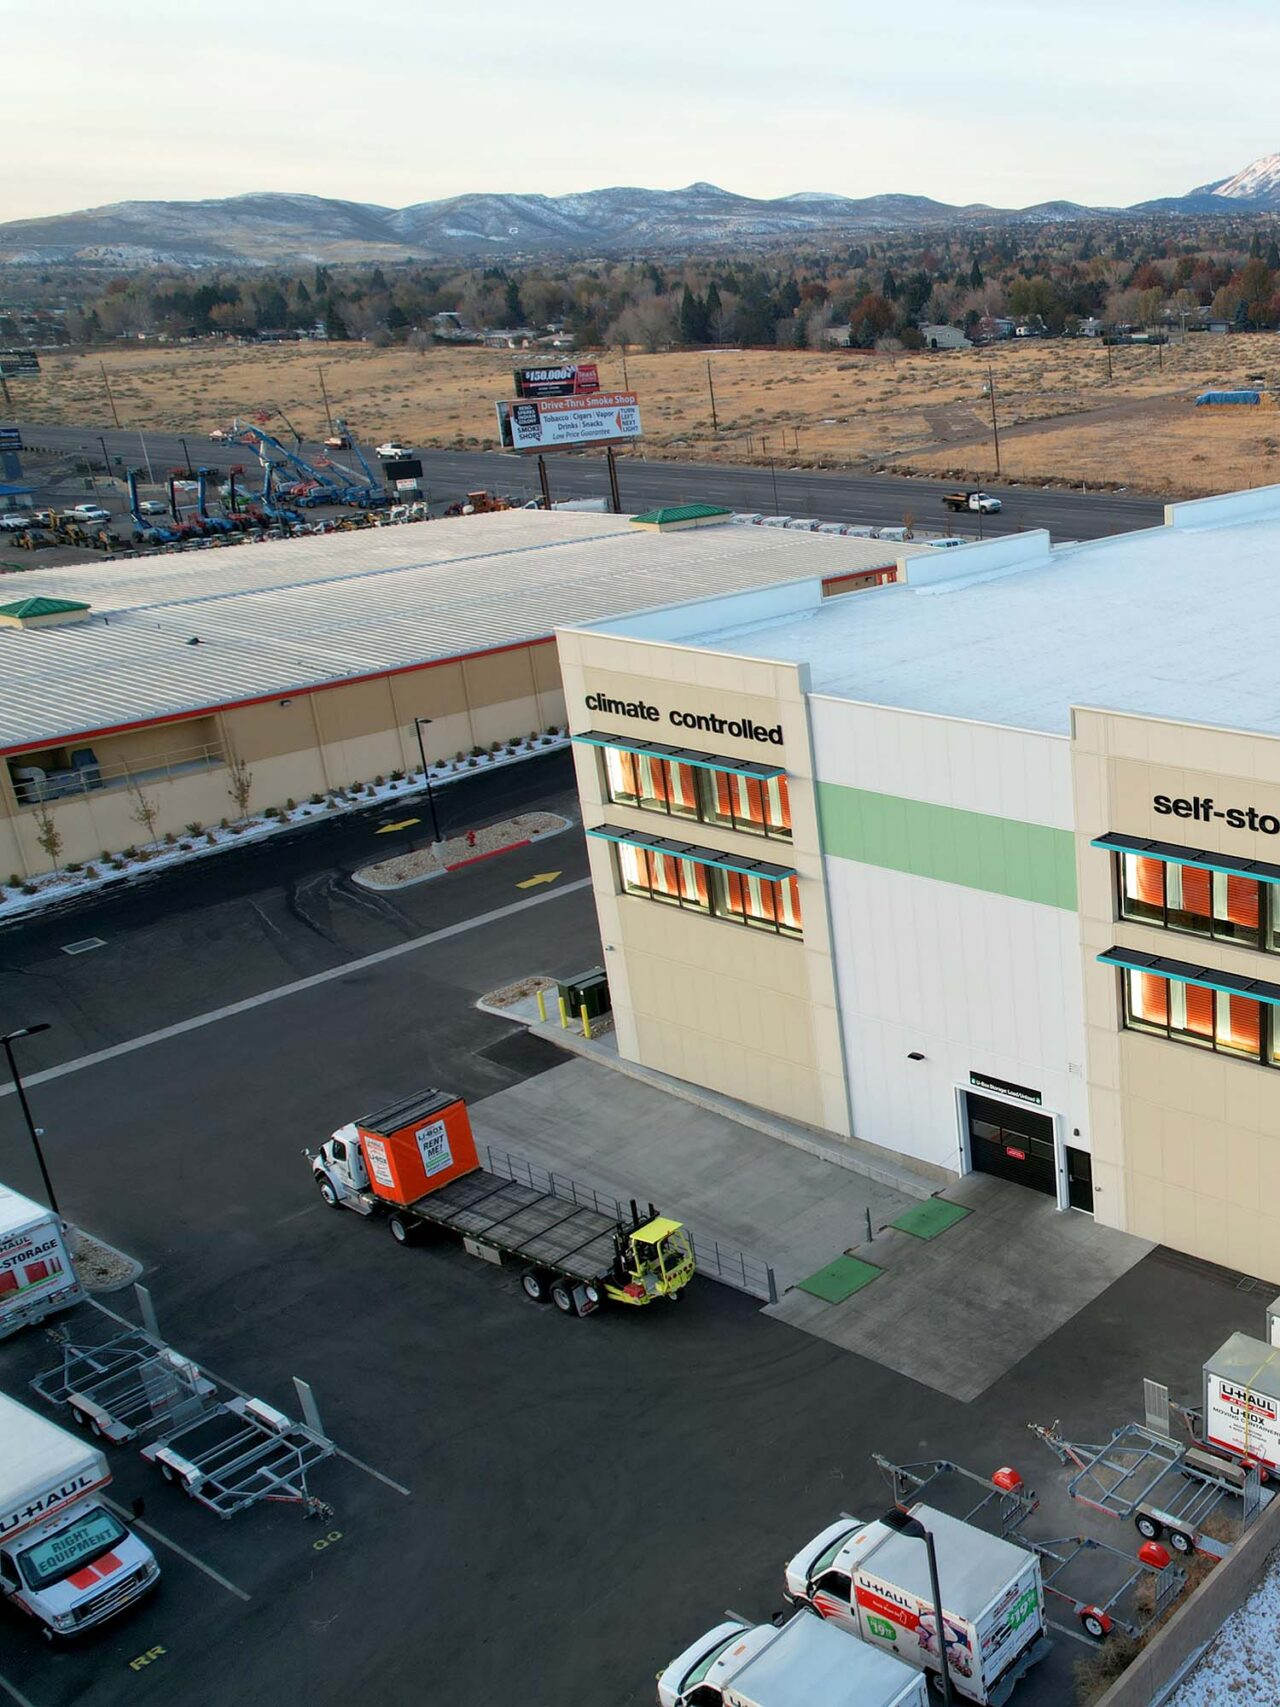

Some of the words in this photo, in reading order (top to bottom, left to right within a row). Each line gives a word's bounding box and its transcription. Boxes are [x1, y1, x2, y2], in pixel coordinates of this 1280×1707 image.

[541, 399, 585, 410] Drive-Thru
[586, 398, 612, 406] Smoke
[614, 395, 635, 405] Shop
[543, 415, 570, 423] Tobacco
[573, 411, 593, 421] Cigars
[595, 411, 614, 420] Vapor
[557, 422, 579, 430] Drinks
[582, 420, 603, 428] Snacks
[517, 425, 540, 433] SMOKE
[552, 432, 565, 440] Low
[580, 428, 611, 437] Guarantee
[585, 693, 660, 721] climate
[669, 708, 784, 745] controlled
[423, 1133, 444, 1151] RENT
[427, 1143, 444, 1157] ME!
[1222, 1384, 1275, 1413] U-HAUL
[1213, 1406, 1240, 1421] MOVING
[0, 1477, 93, 1533] U-HAUL
[51, 1527, 91, 1554] RIGHT
[38, 1528, 114, 1573] EQUIPMENT
[859, 1577, 913, 1610] U-HAUL
[129, 1645, 167, 1672] RR
